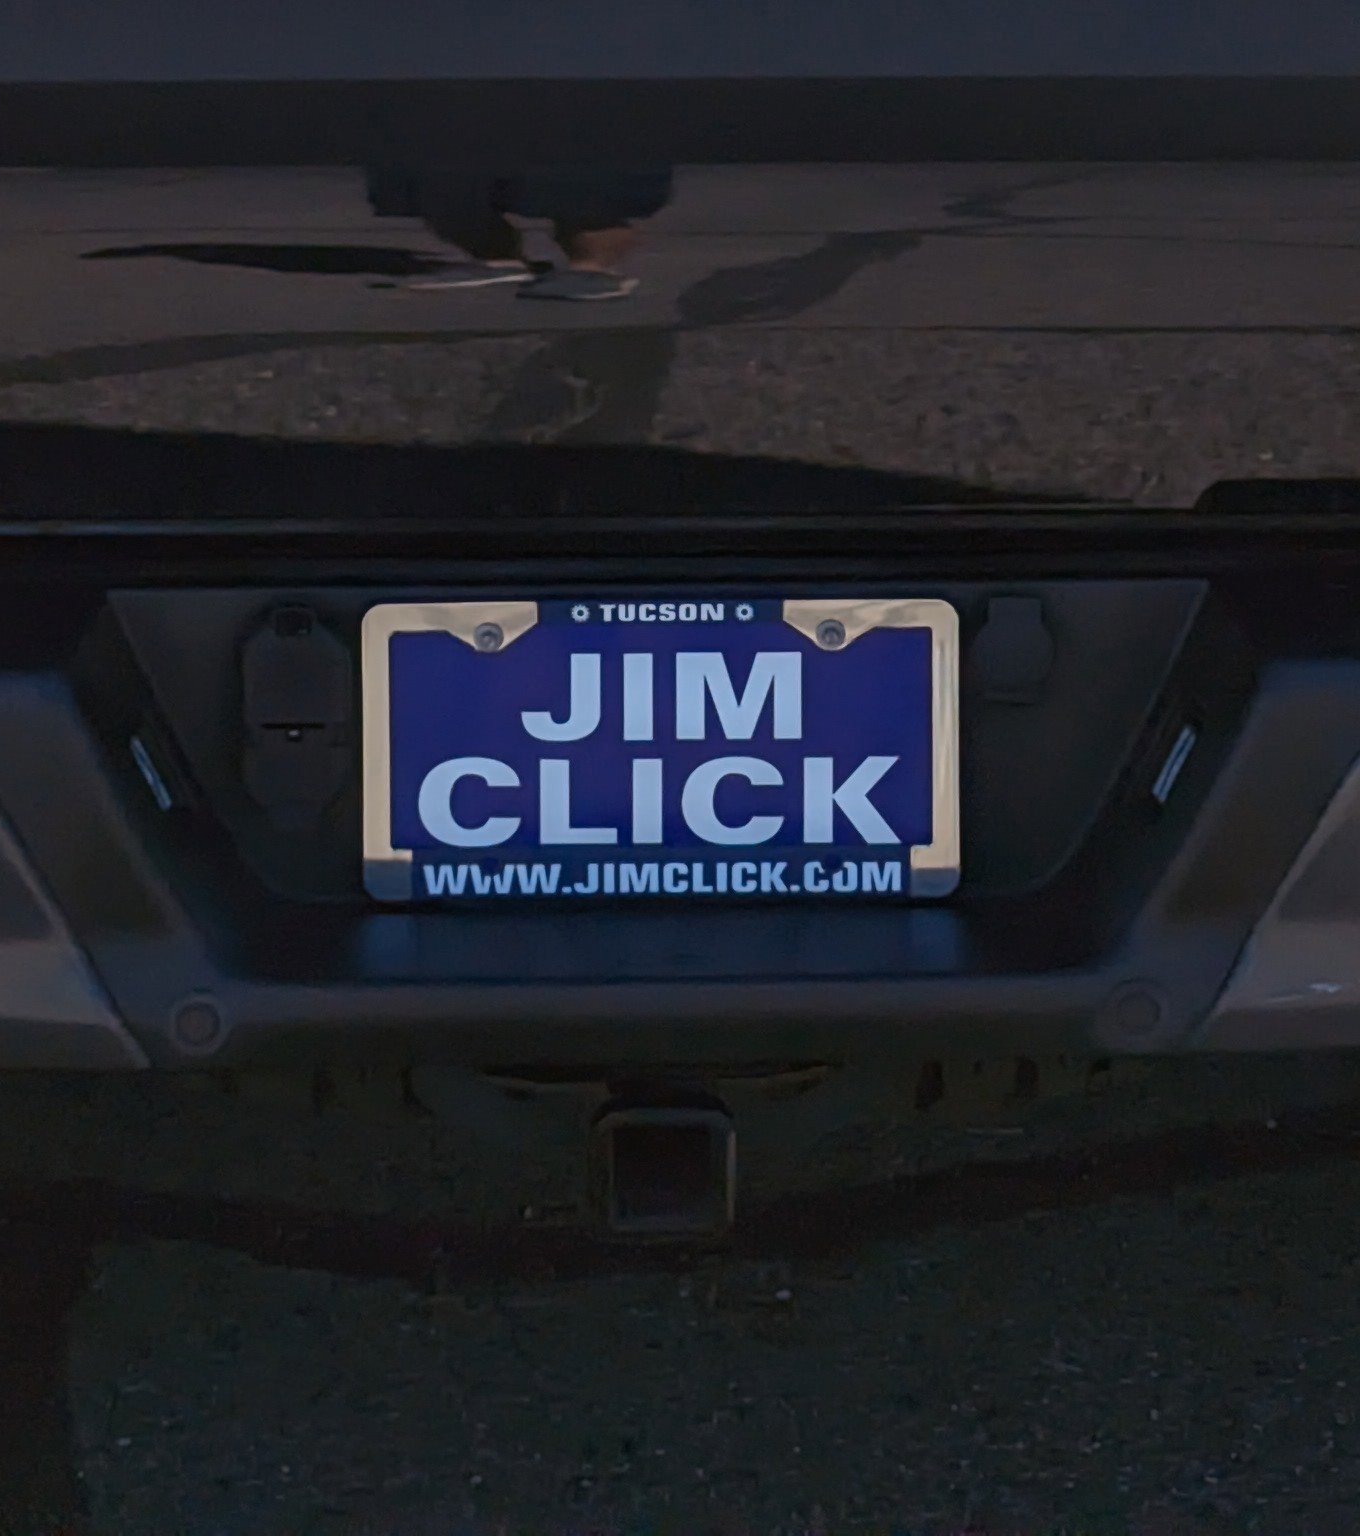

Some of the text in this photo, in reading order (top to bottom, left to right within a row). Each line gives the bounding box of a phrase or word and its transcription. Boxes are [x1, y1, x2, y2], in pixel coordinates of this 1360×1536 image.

[599, 603, 725, 622] TUCSON
[521, 651, 803, 742] JIM
[417, 755, 902, 848] CLICK
[424, 860, 903, 897] WWW.JIMCLICK.COM
